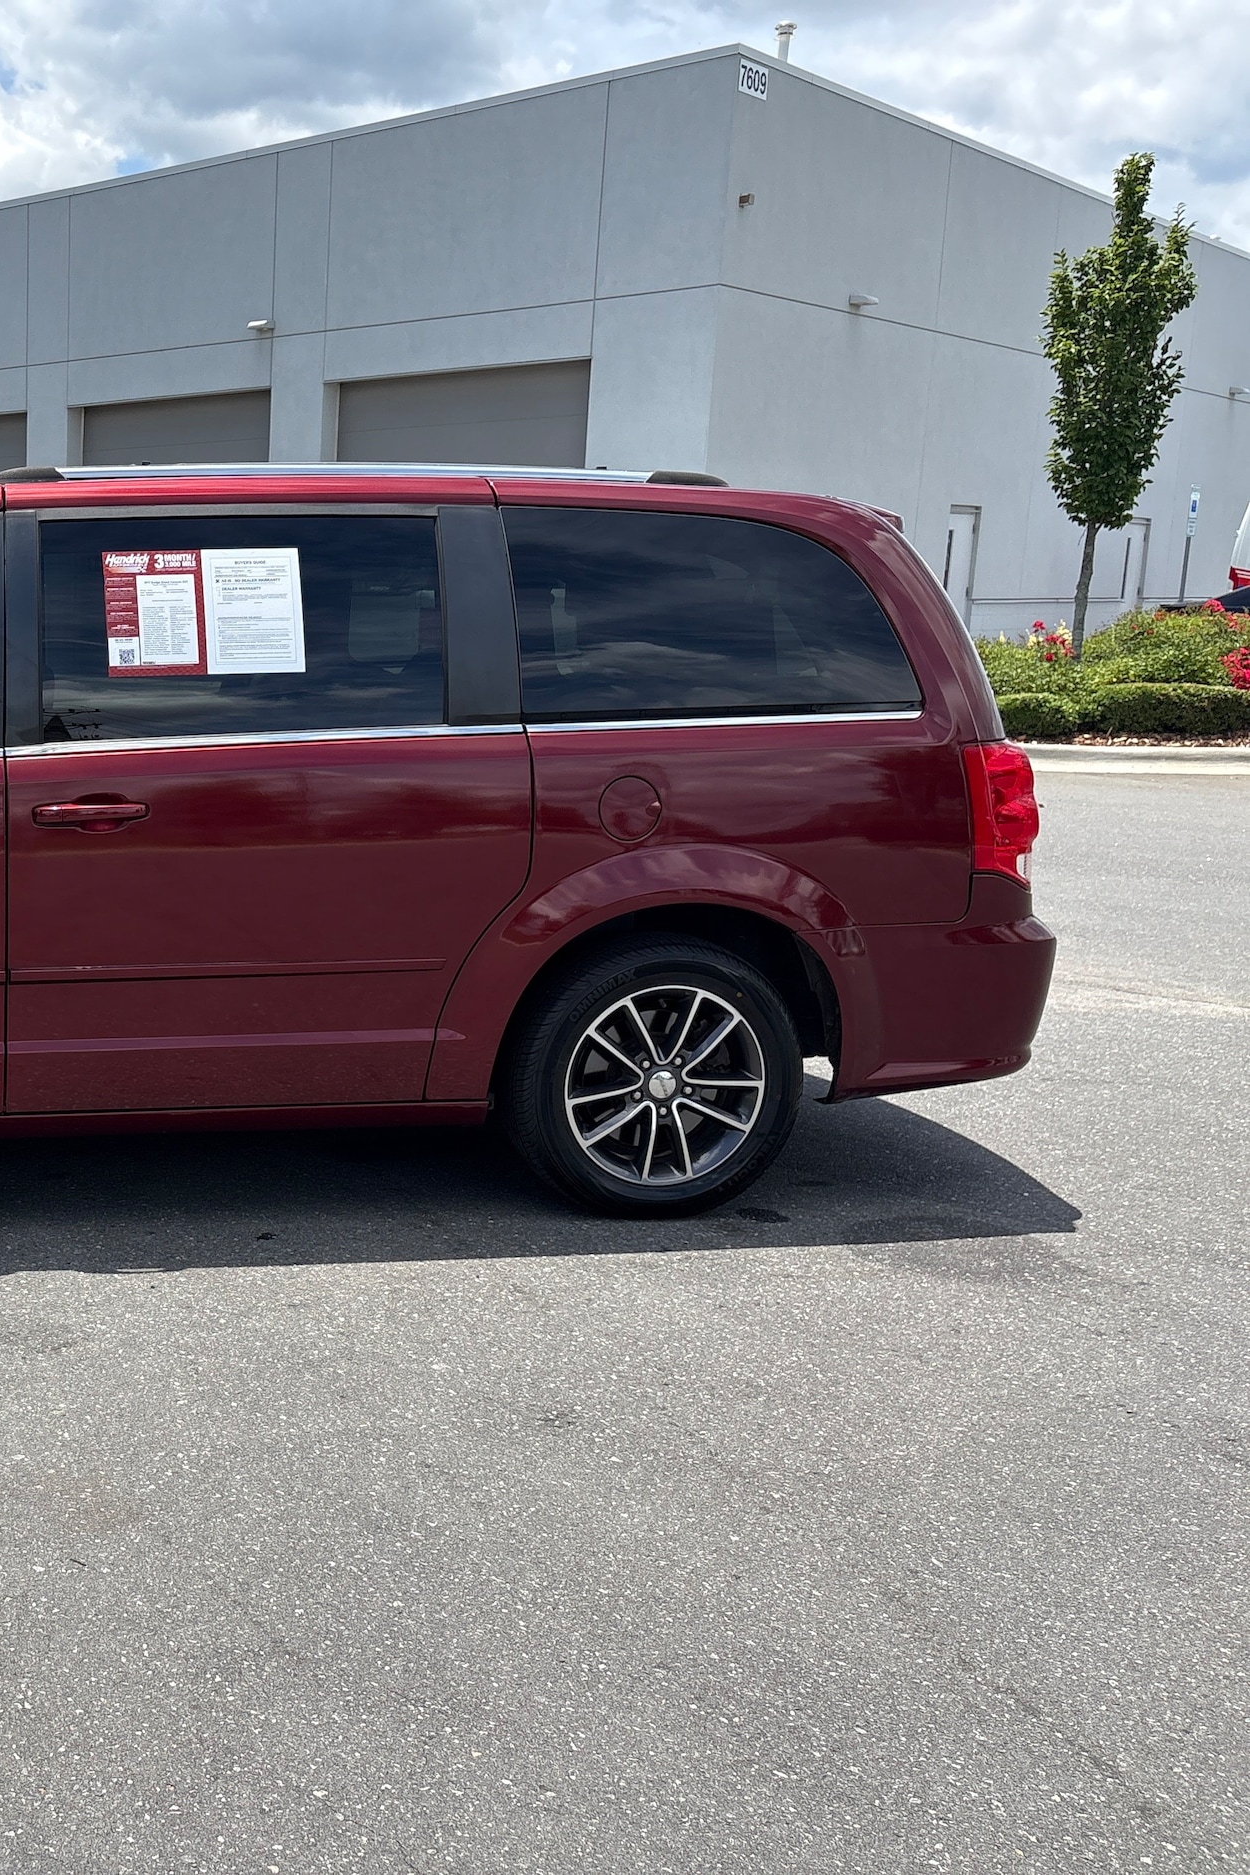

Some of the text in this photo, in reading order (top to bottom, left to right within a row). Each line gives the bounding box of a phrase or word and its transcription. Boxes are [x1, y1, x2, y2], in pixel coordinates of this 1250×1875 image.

[741, 64, 767, 95] 7609
[105, 553, 150, 568] Hendrick
[154, 553, 164, 568] 3
[568, 967, 639, 1023] OMNIMAX
